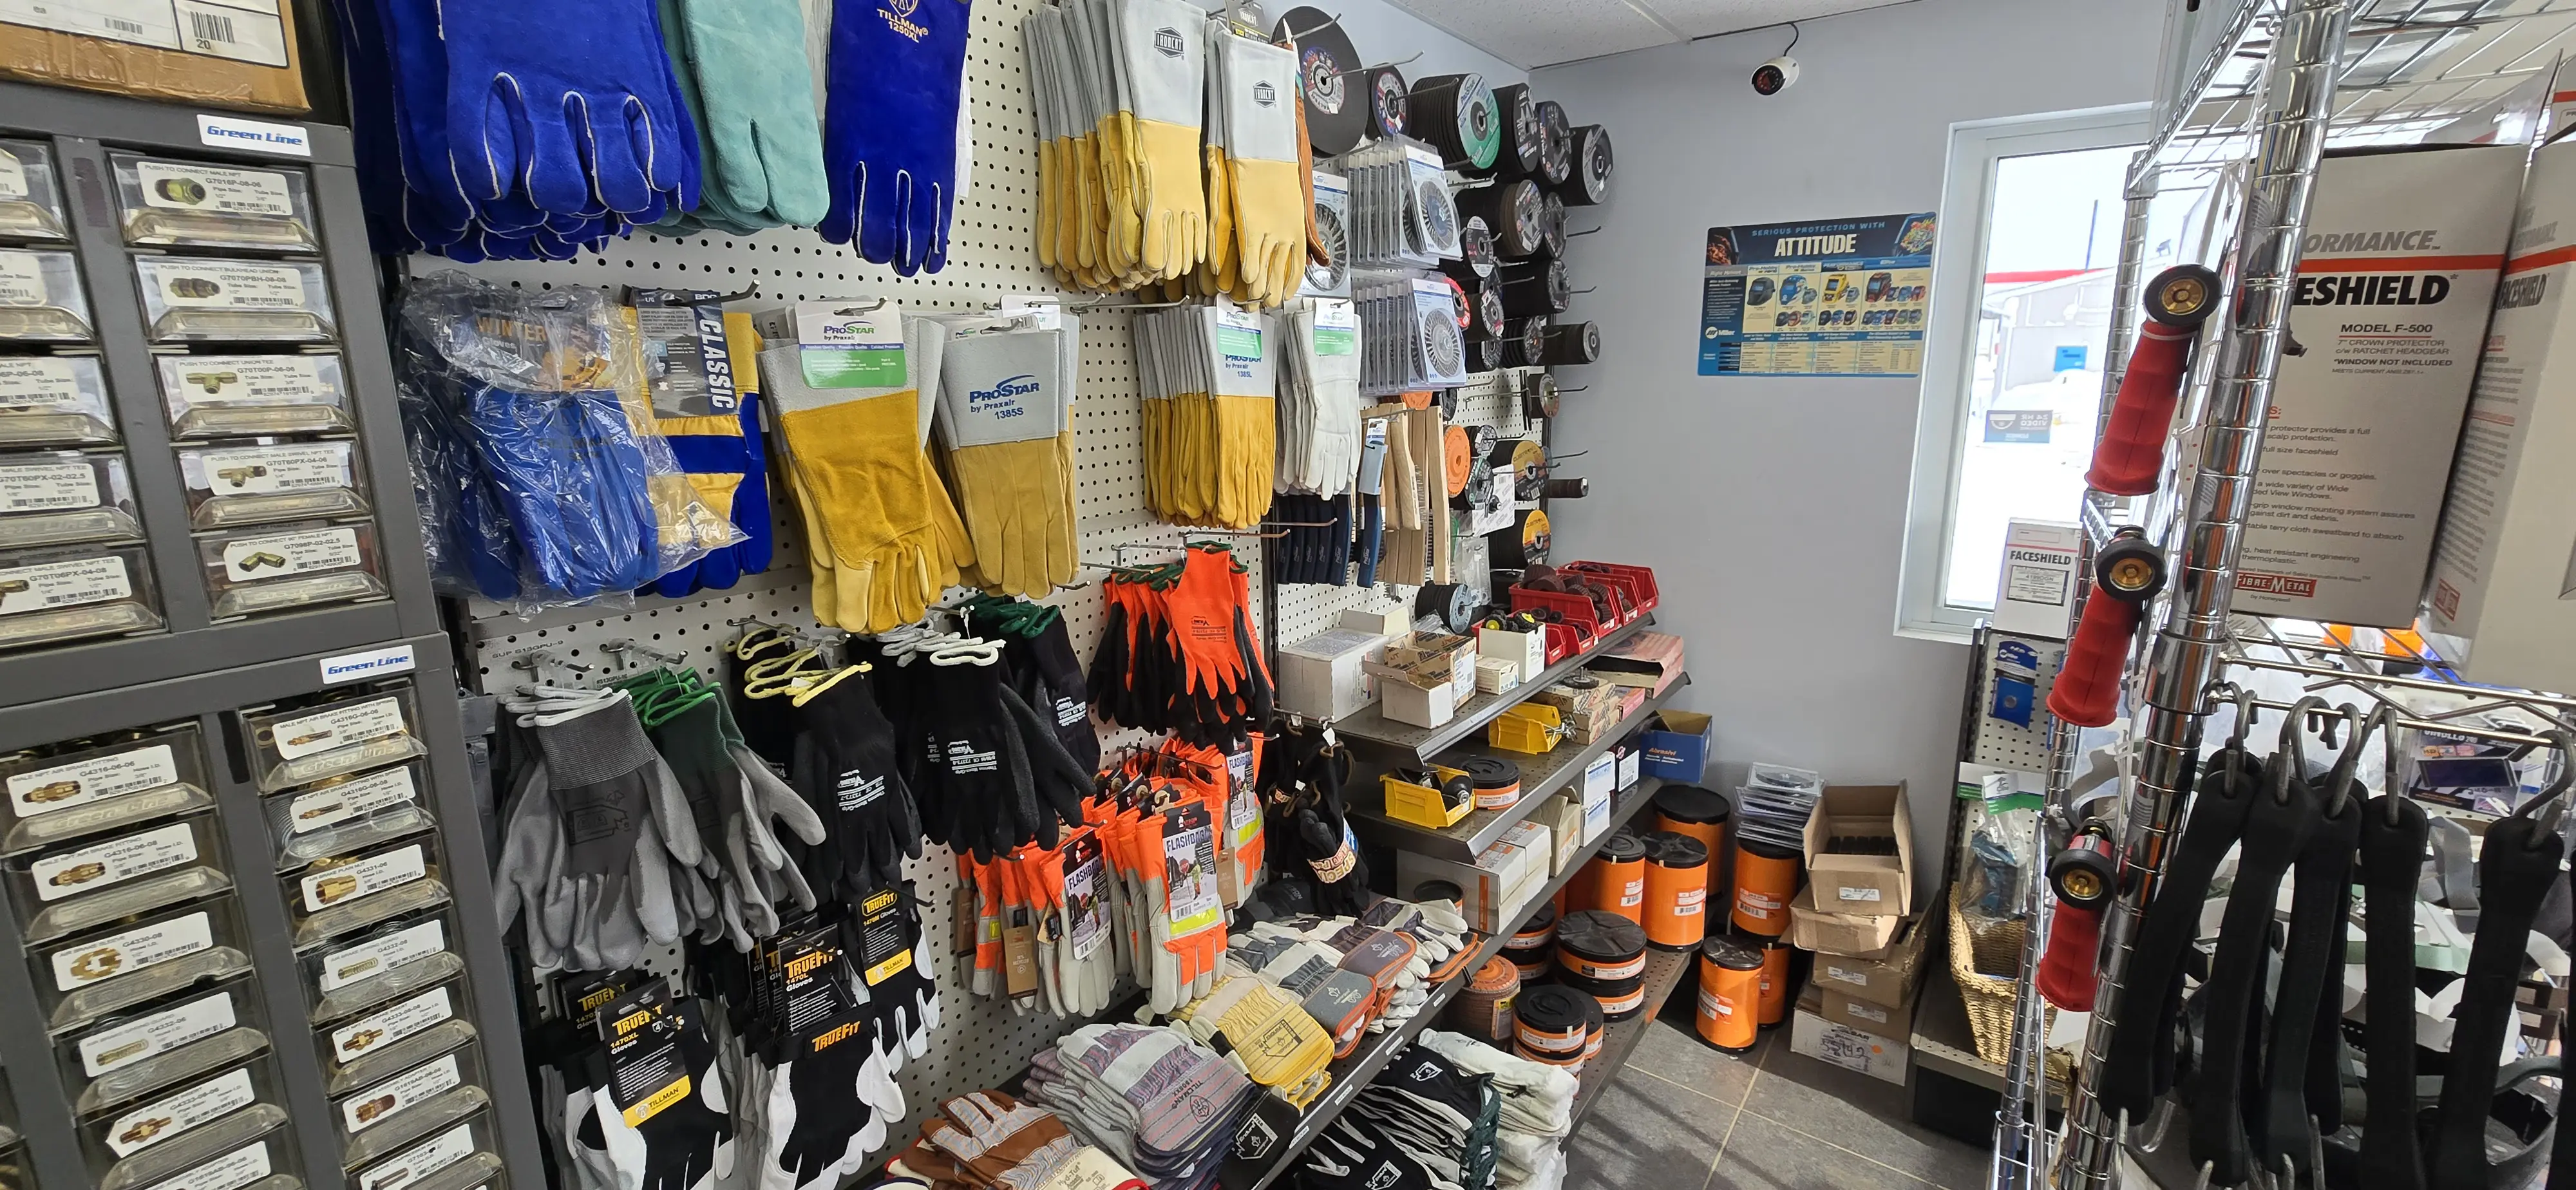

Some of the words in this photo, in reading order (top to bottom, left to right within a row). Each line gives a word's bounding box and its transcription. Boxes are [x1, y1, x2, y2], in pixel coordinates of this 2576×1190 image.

[888, 21, 920, 43] 1250XL
[196, 39, 211, 50] 20
[207, 125, 261, 142] Green
[265, 132, 303, 146] Line
[1752, 228, 1791, 237] SERIOUS
[1795, 223, 1856, 234] PROTECTION
[1860, 222, 1886, 230] WITH
[1774, 233, 1857, 257] ATTITUDE
[2340, 324, 2391, 333] MODEL
[2394, 324, 2433, 333] F-500
[699, 319, 735, 409] CLASSIC
[984, 399, 1016, 411] Praxair
[994, 407, 1024, 420] 1385S
[2270, 425, 2309, 433] protector
[2310, 426, 2347, 435] provides
[2356, 427, 2371, 435] full
[2267, 433, 2289, 441] scalp
[2291, 433, 2336, 442] protection.
[2295, 447, 2339, 456] faceshield
[2282, 468, 2327, 478] spectacles
[2340, 471, 2377, 480] goggles.
[2286, 482, 2315, 491] variety
[2291, 491, 2332, 500] Windows.
[2271, 503, 2304, 511] window
[2304, 505, 2345, 515] mounting
[2346, 507, 2378, 517] system
[2380, 511, 2416, 519] assures
[2309, 514, 2339, 522] debris.
[2269, 525, 2289, 533] terry
[2312, 527, 2360, 538] sweatband
[2372, 533, 2404, 541] absorb
[2009, 550, 2071, 565] FACESHIELD
[2242, 554, 2298, 565] thermoplastic.
[2273, 549, 2309, 558] resistant
[2310, 552, 2360, 563] engineering
[2259, 594, 2291, 603] Honeywell
[328, 660, 375, 675] Green
[377, 654, 409, 667] Line
[863, 892, 895, 913] TRUEFIT
[863, 915, 880, 927] 1470M
[880, 907, 896, 919] Gloves
[882, 958, 904, 972] TILLMAN
[786, 972, 809, 985] 1470L
[786, 977, 813, 993] Gloves
[576, 1018, 597, 1030] Glove
[610, 1032, 639, 1048] 1470XL
[811, 1021, 860, 1053] TRUEFIT
[611, 1039, 638, 1055] Gloves
[649, 1086, 680, 1108] TILLMAN
